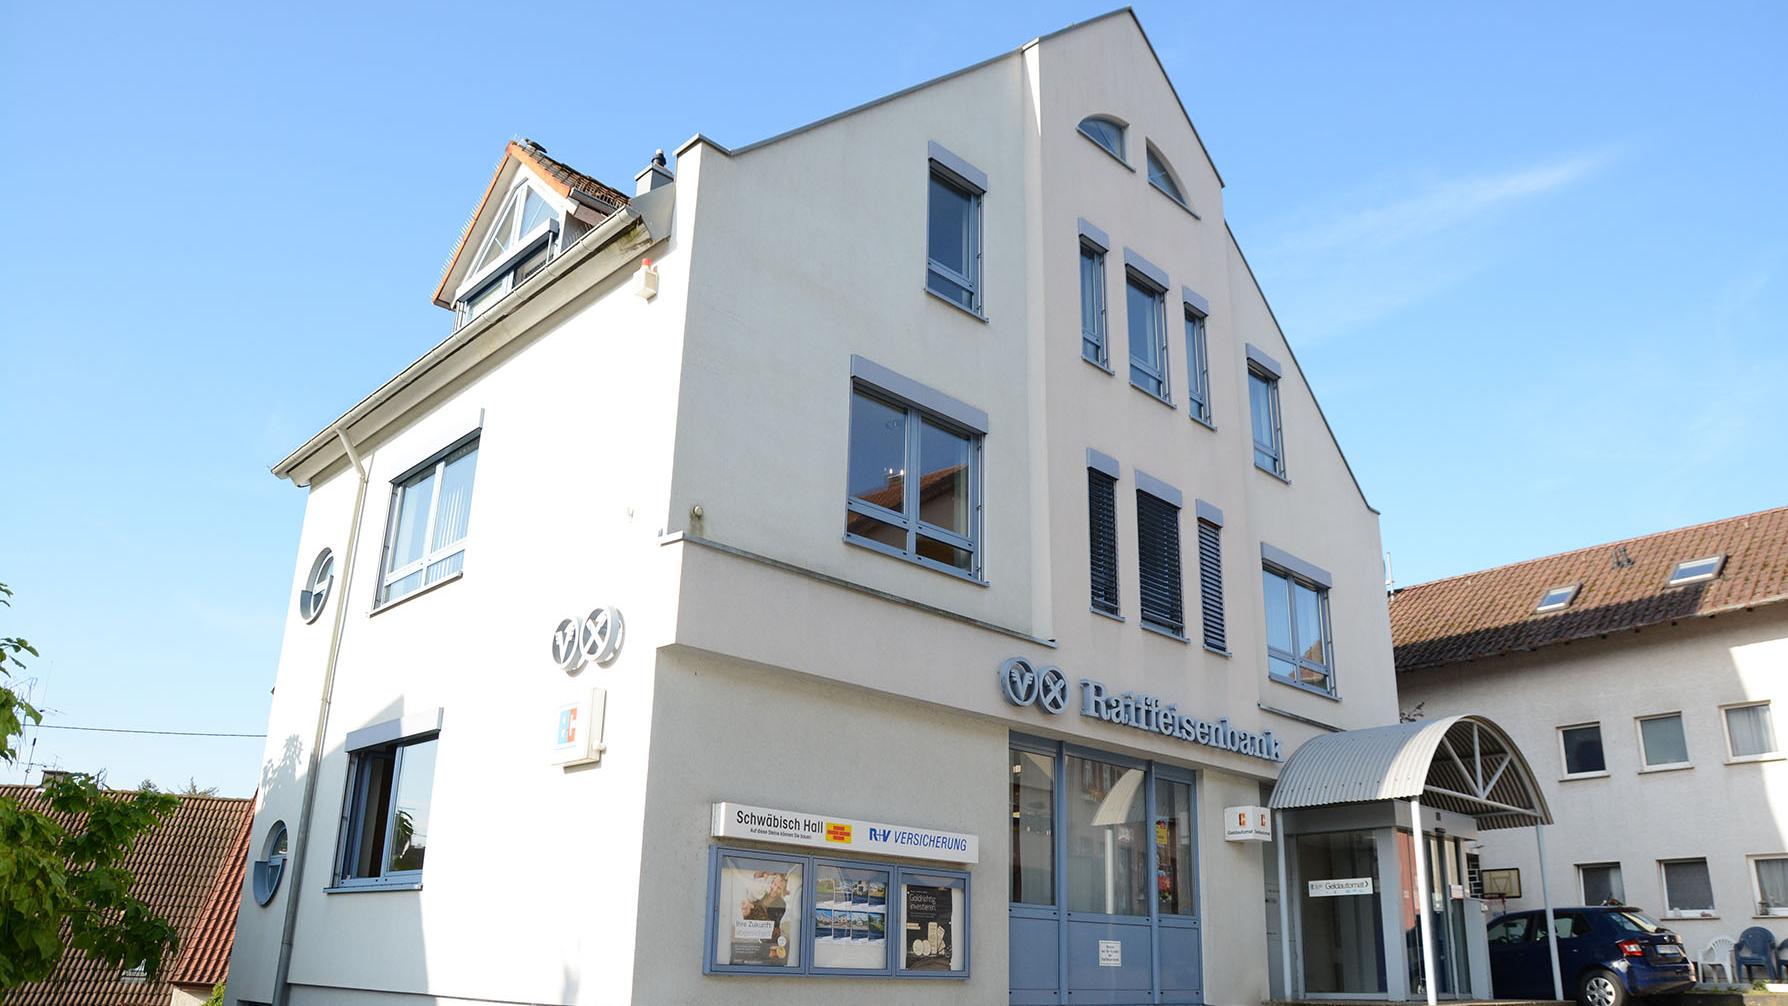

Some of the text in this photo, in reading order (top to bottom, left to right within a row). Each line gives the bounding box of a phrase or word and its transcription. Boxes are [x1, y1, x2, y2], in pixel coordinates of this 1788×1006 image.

[1080, 679, 1284, 762] Raiffeisenbank
[736, 810, 801, 831] Schwäbisch
[804, 819, 824, 834] Hall
[869, 827, 891, 844] R+V
[893, 831, 967, 852] VERSICHERUNG
[1325, 880, 1364, 890] Geldautomat
